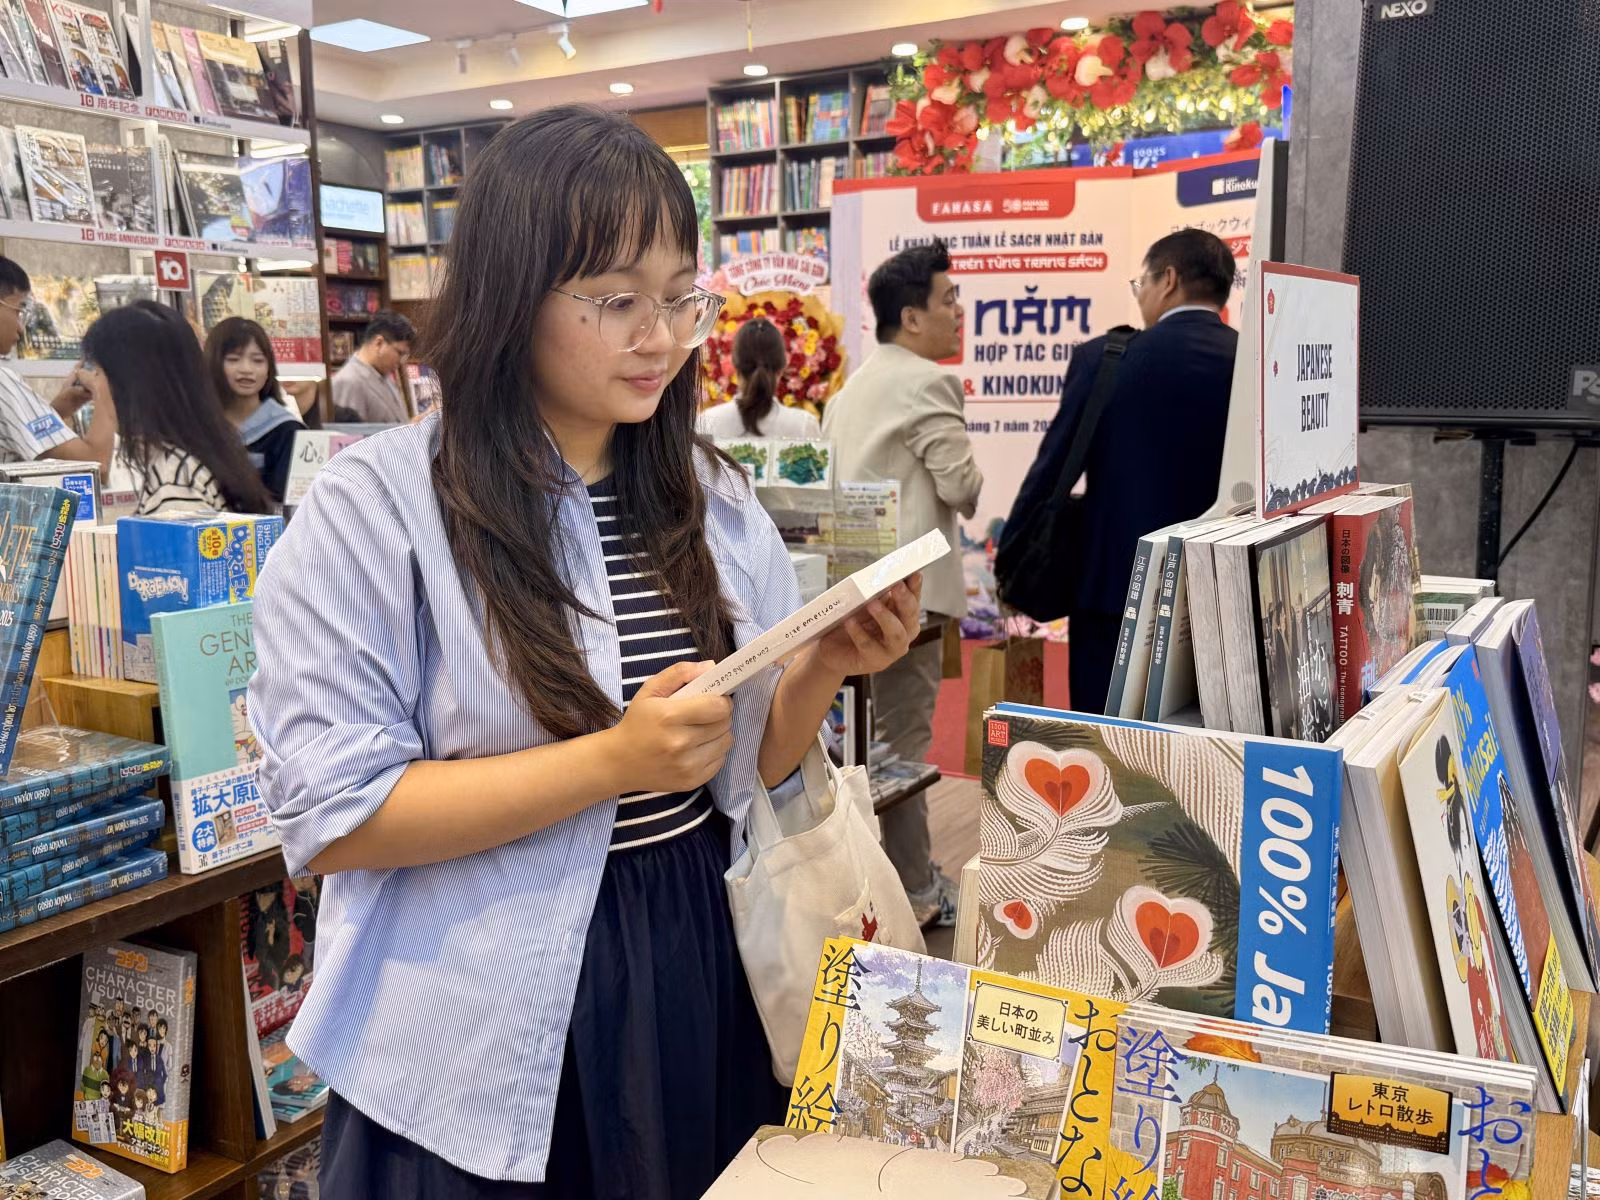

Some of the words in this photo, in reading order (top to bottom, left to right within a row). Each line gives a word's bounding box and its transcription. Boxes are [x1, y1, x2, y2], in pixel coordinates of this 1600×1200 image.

[1380, 0, 1427, 18] NEXO
[80, 93, 94, 107] 10
[932, 200, 993, 216] FAHASA
[81, 228, 95, 241] 10
[97, 232, 117, 242] YEARS
[118, 233, 159, 246] ANNIVERSARY
[962, 233, 990, 248] TUẦN
[1045, 232, 1075, 249] NHẬT
[160, 260, 184, 281] 10
[974, 343, 1008, 365] HỢP
[1014, 341, 1046, 362] TÁC
[1297, 344, 1333, 381] JAPANESE
[963, 379, 976, 395] &
[1301, 392, 1329, 432] BEAUTY
[994, 420, 1000, 432] 7
[1003, 421, 1029, 432] năm
[1336, 581, 1354, 615] 刺青
[231, 612, 253, 626] THE
[1339, 626, 1348, 666] TATTOO
[991, 730, 1006, 739] ART
[1258, 765, 1314, 936] 100%
[86, 966, 176, 1003] CHARACTER
[86, 980, 132, 1005] VISUAL
[136, 995, 175, 1017] BOOK
[999, 1001, 1039, 1022] 日本の
[976, 1014, 1055, 1045] 美しい町並み
[1372, 1082, 1409, 1103] 東京
[1349, 1102, 1434, 1126] レトロ散歩
